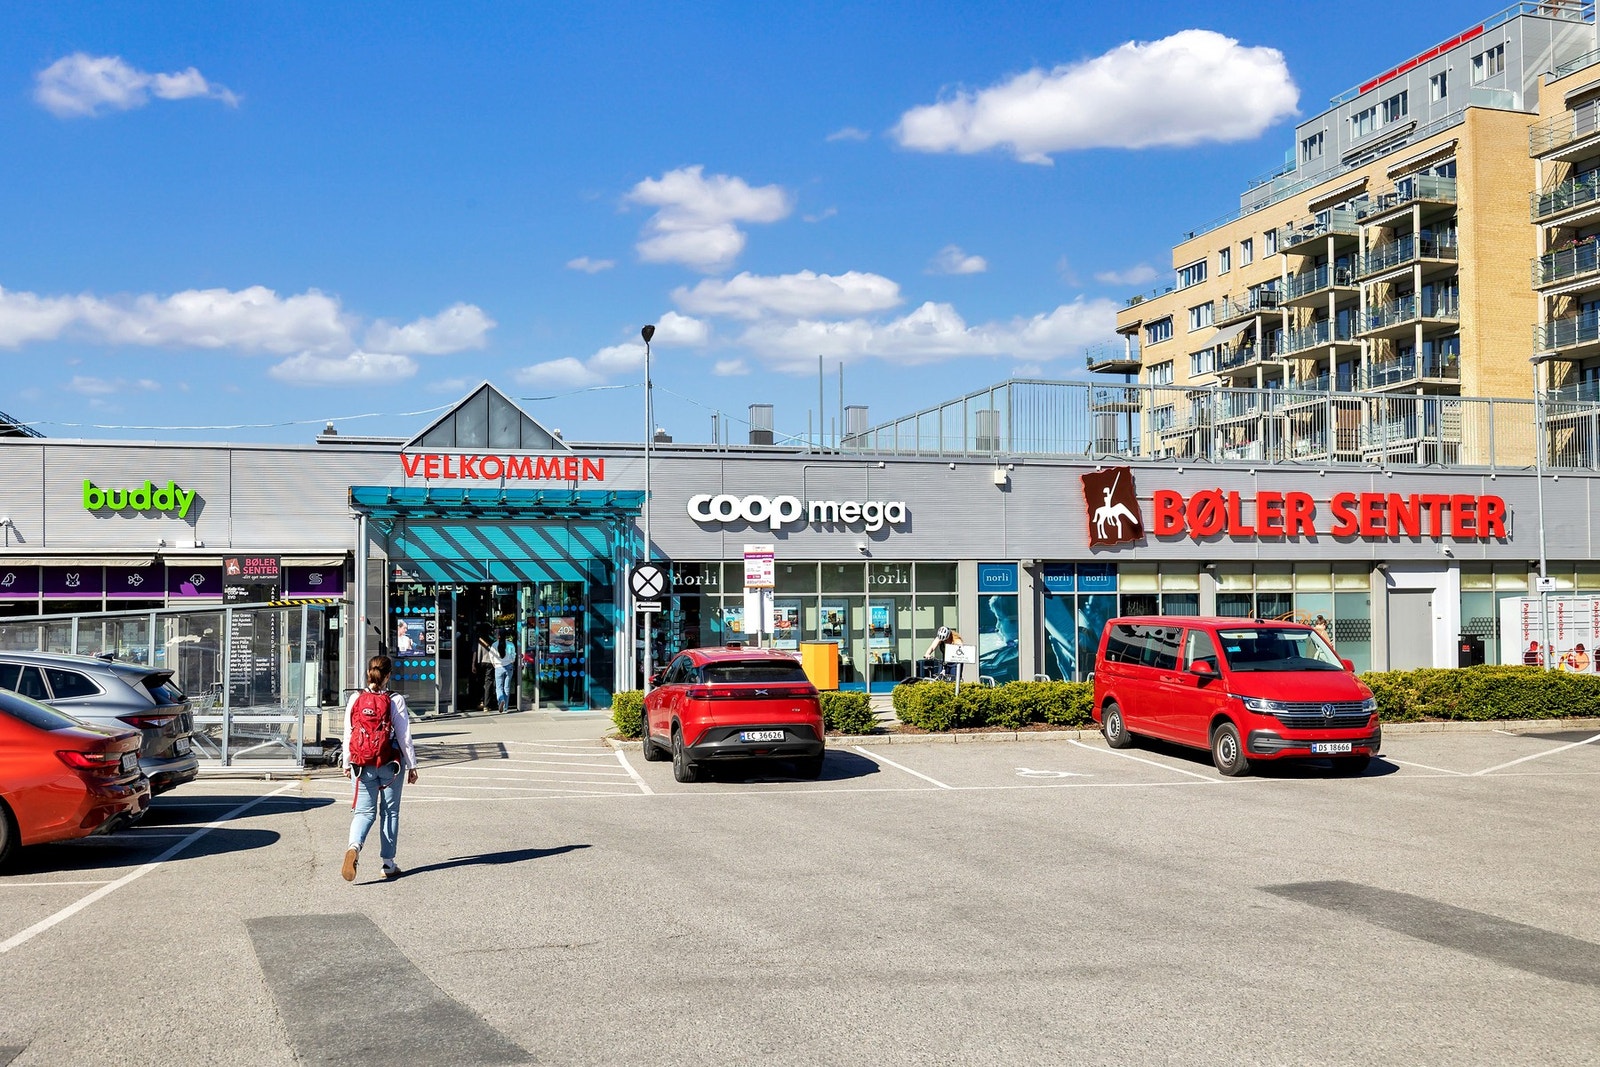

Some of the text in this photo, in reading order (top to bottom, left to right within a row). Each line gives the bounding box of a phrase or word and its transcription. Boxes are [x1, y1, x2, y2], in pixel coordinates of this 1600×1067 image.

[401, 454, 605, 481] VELKOMMEN
[83, 480, 195, 519] buddy
[687, 494, 907, 532] coop mega
[1153, 487, 1507, 540] BØLER SENTER
[245, 558, 276, 566] BØLER
[243, 566, 278, 574] SENTER
[672, 569, 718, 586] norli
[867, 569, 908, 585] norli
[986, 572, 1009, 582] norli
[1047, 572, 1070, 582] norli
[1085, 572, 1108, 582] norli
[746, 731, 783, 740] EC 36626
[1318, 743, 1350, 752] DS 18666
